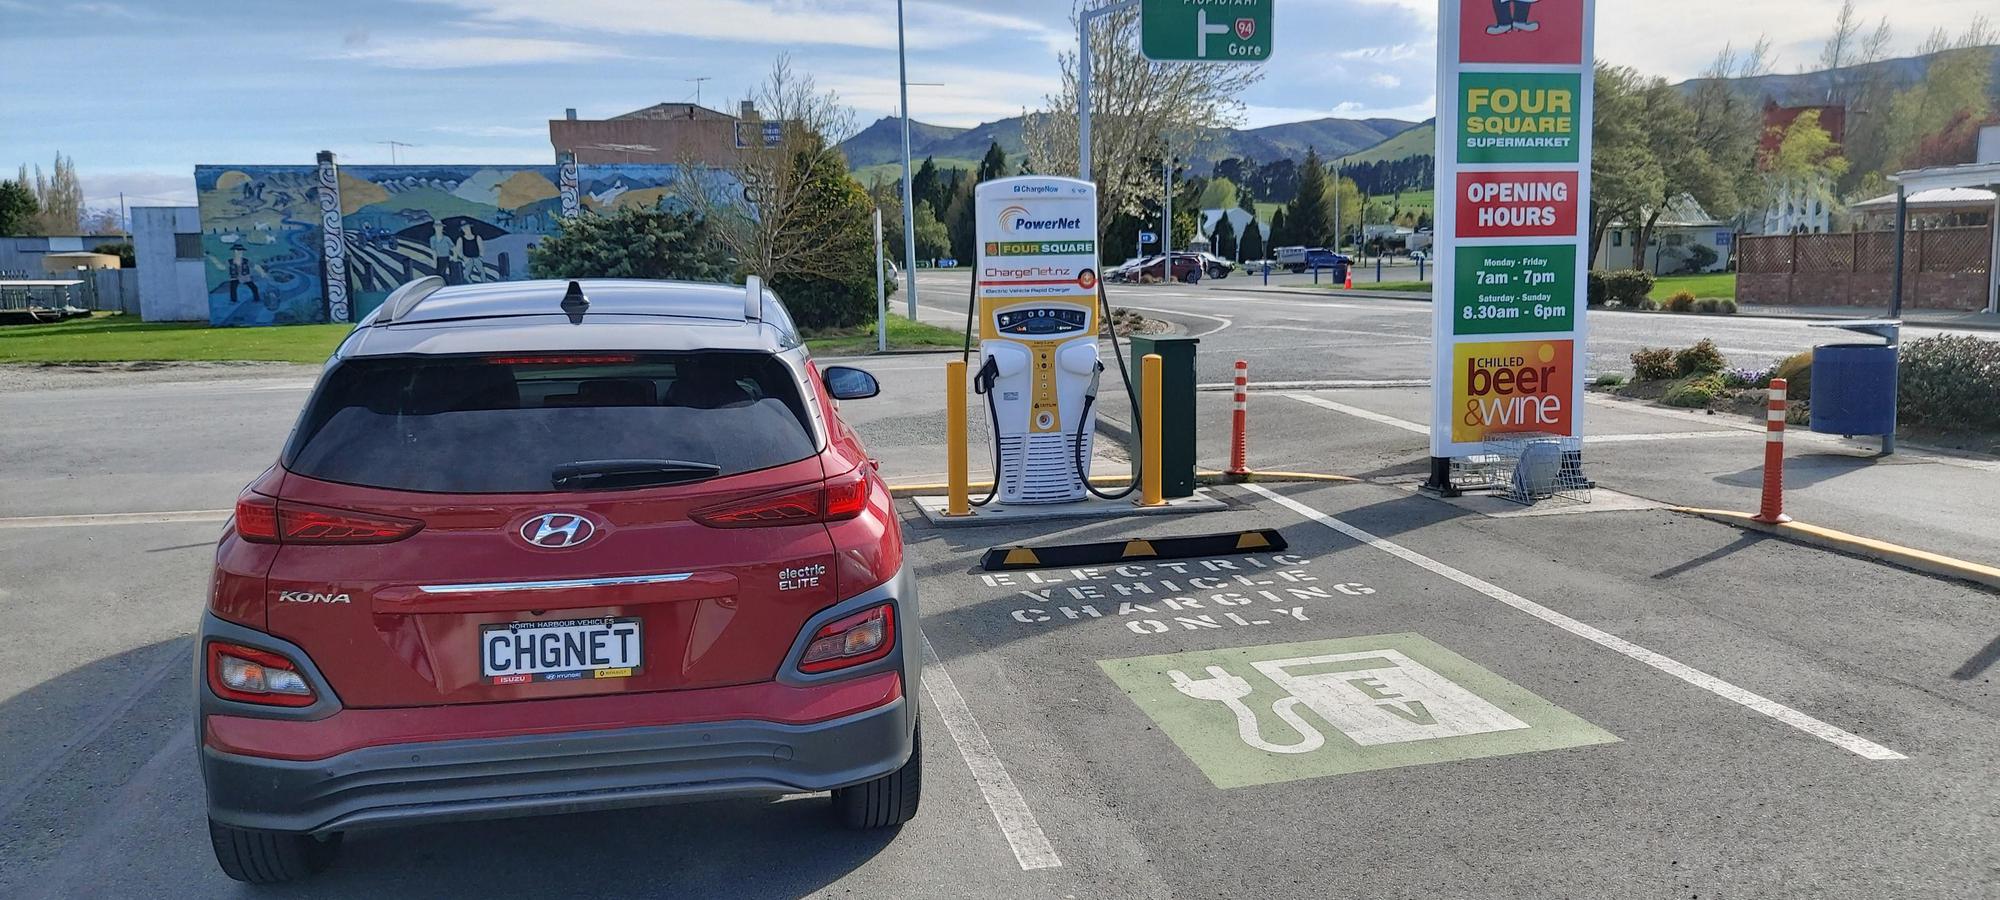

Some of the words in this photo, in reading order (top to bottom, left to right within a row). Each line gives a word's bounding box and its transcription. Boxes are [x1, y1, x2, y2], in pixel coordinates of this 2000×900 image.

[1238, 22, 1252, 34] 94
[1228, 43, 1261, 56] Gore
[1467, 89, 1572, 114] FOUR
[1467, 116, 1571, 135] SQUARE
[1467, 137, 1571, 148] SUPERMARKET
[1021, 185, 1059, 193] ChargeNow
[1467, 182, 1567, 203] OPENING
[1015, 218, 1080, 230] PowerNet
[1478, 207, 1556, 227] HOURS
[1003, 244, 1039, 253] FOUR
[1041, 243, 1093, 253] SQUARE
[1484, 258, 1516, 268] Monday
[1523, 257, 1548, 267] Friday
[985, 267, 1071, 279] ChargeNet.nz
[1476, 271, 1508, 285] 7am
[1523, 270, 1555, 285] 7pm
[1478, 294, 1515, 303] Saturday
[1522, 293, 1551, 303] Sunday
[1462, 305, 1519, 320] 8.30am
[1534, 304, 1566, 320] 6pm
[1477, 357, 1524, 368] CHILLED
[1467, 358, 1556, 396] beer
[778, 564, 826, 579] electric
[981, 553, 1311, 587] ELECTRIC
[779, 577, 819, 591] ELITE
[1020, 569, 1318, 602] VEHICLE
[279, 591, 351, 604] KONA
[1010, 582, 1376, 624] CHARGING
[509, 623, 535, 631] NORTH
[537, 620, 575, 629] HARBOUR
[577, 618, 615, 627] VEHICLES
[1125, 606, 1310, 635] ONLY
[489, 628, 634, 671] CHGNET
